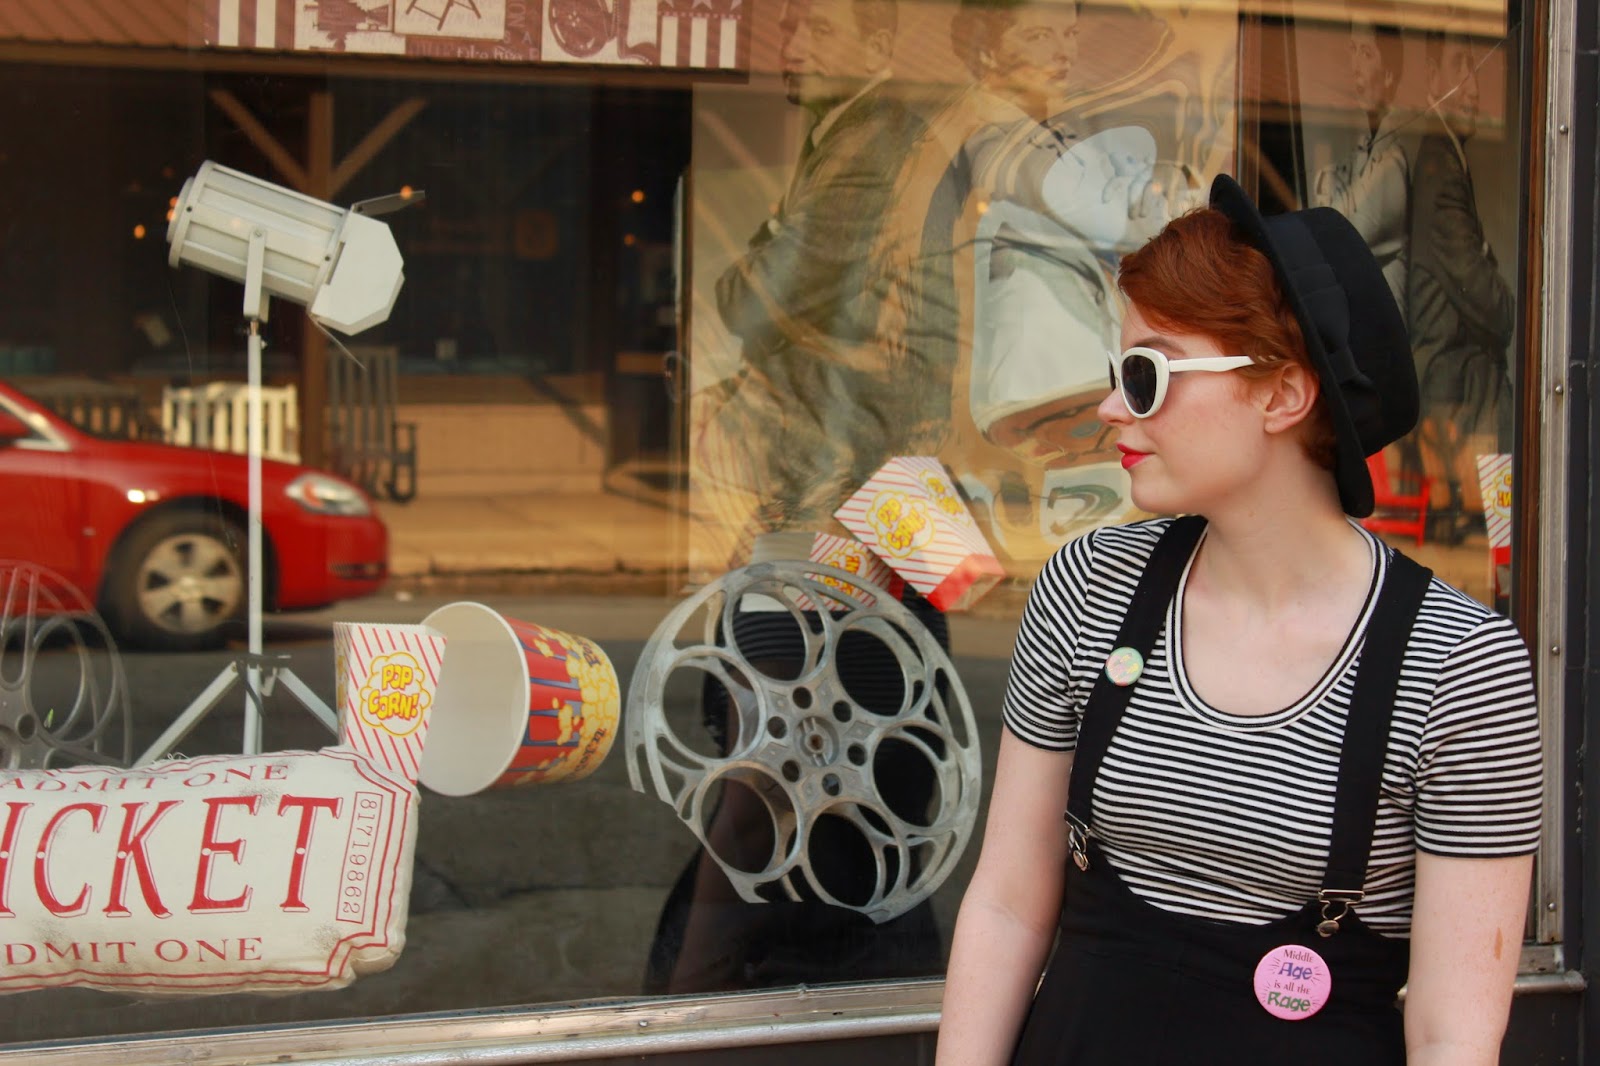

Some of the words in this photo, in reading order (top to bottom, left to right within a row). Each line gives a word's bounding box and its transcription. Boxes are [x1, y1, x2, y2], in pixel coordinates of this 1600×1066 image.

[381, 663, 414, 691] POP
[367, 688, 420, 721] CORN!
[0, 776, 167, 793] ADMIT
[183, 764, 289, 788] ONE
[341, 797, 379, 915] 81719862
[155, 937, 263, 963] ONE
[1283, 948, 1315, 963] Middle
[1278, 961, 1313, 981] Age
[1273, 979, 1281, 988] is
[1283, 982, 1295, 992] all
[1297, 984, 1312, 995] the
[1267, 991, 1312, 1012] Rage
